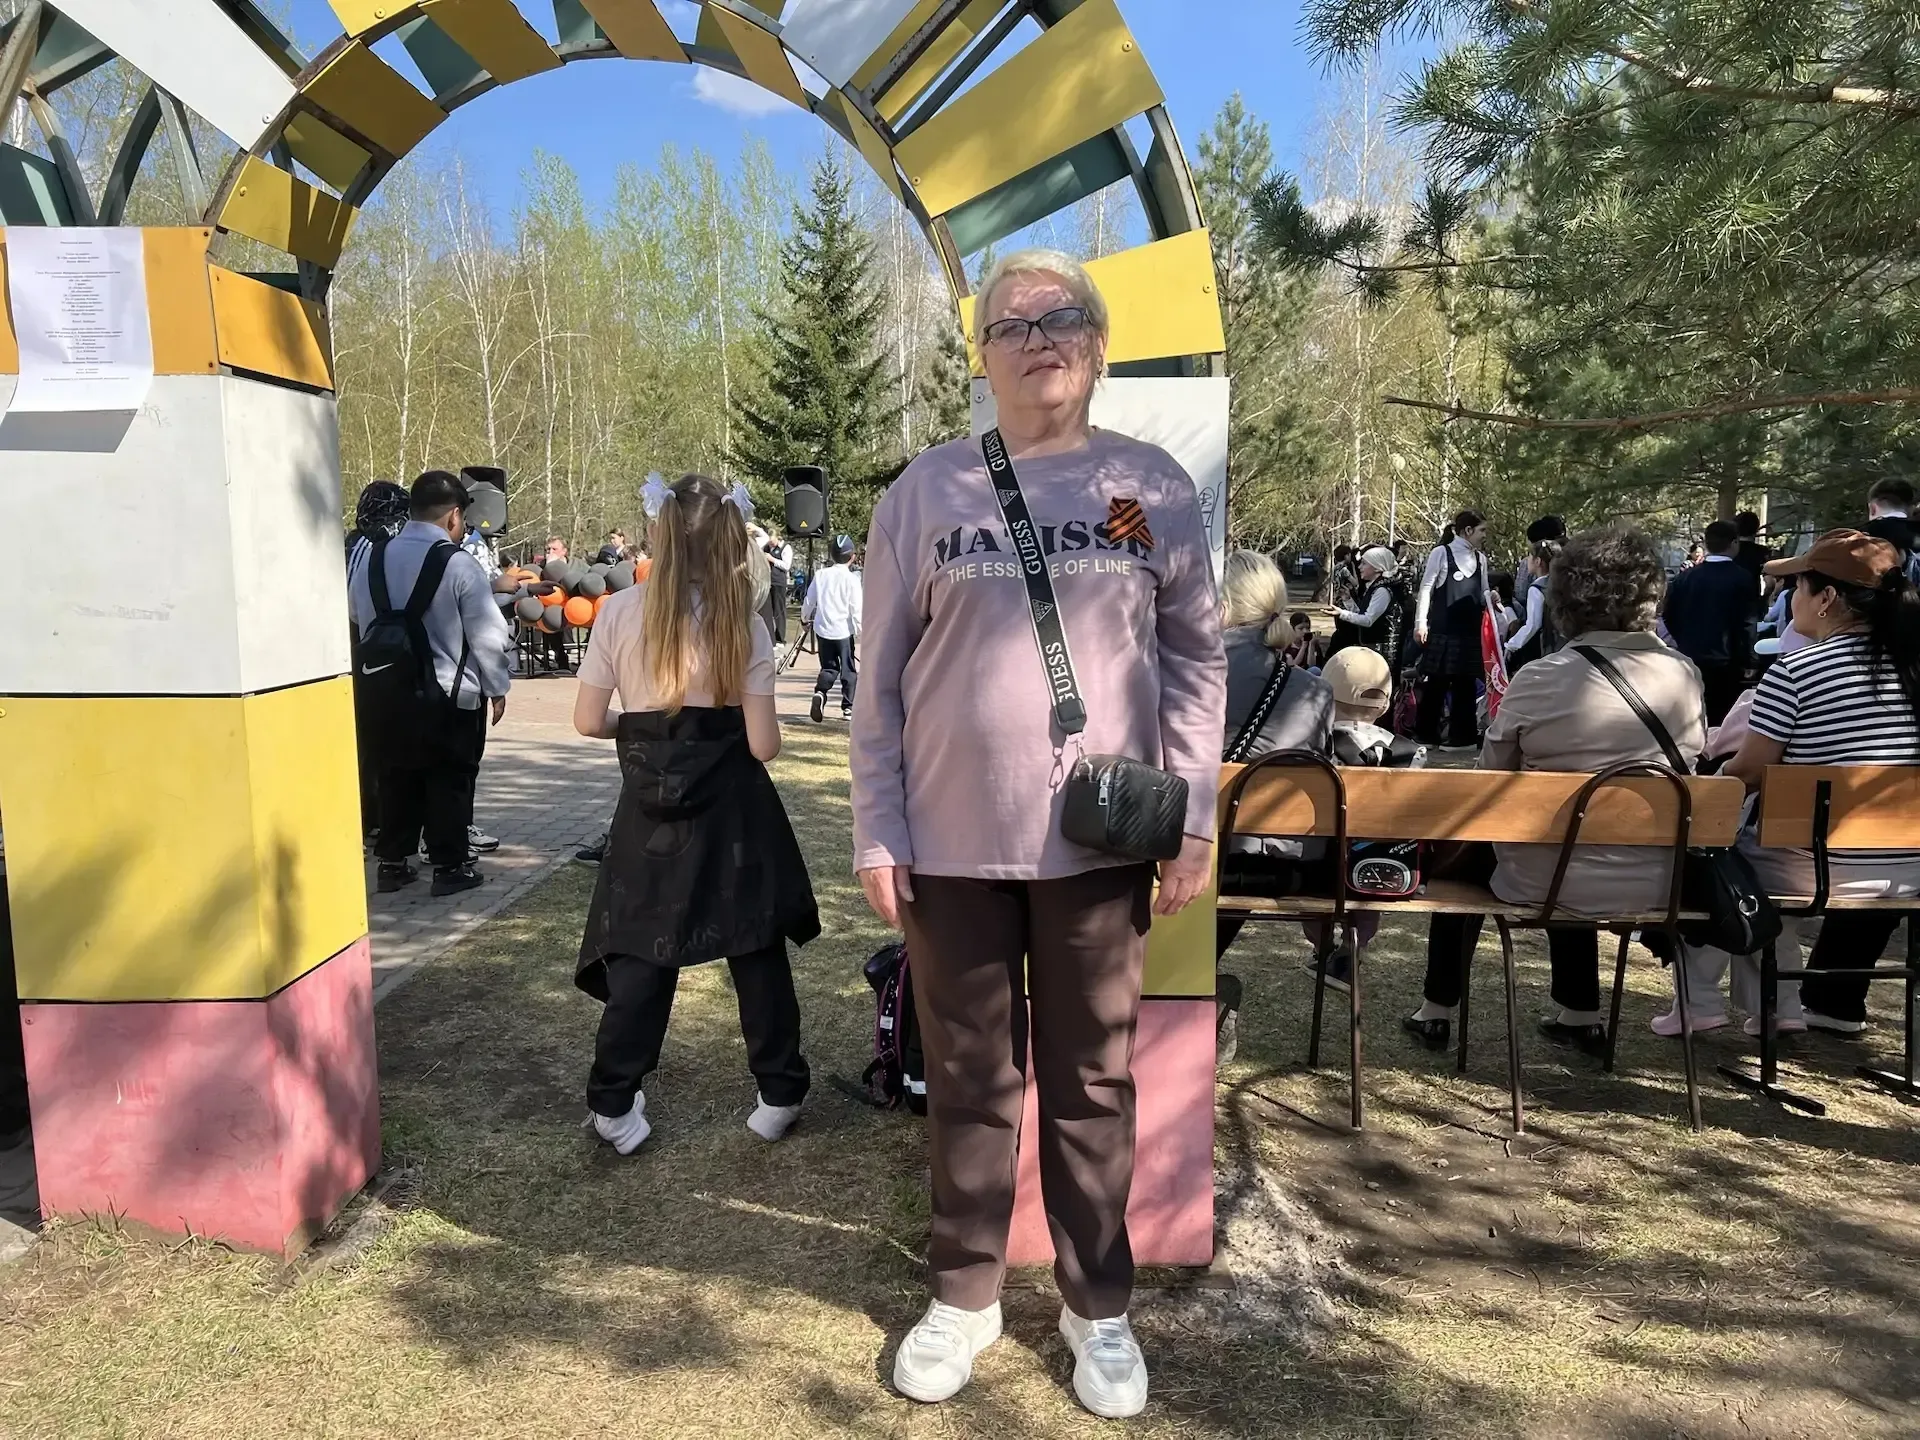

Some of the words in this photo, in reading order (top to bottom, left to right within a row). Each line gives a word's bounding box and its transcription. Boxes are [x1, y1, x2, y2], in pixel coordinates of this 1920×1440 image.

[985, 431, 1006, 471] GUESS
[1012, 519, 1042, 575] GUESS
[947, 563, 977, 584] THE
[982, 561, 1060, 579] ESSEE
[1064, 558, 1088, 574] OF
[1094, 558, 1131, 576] LINE
